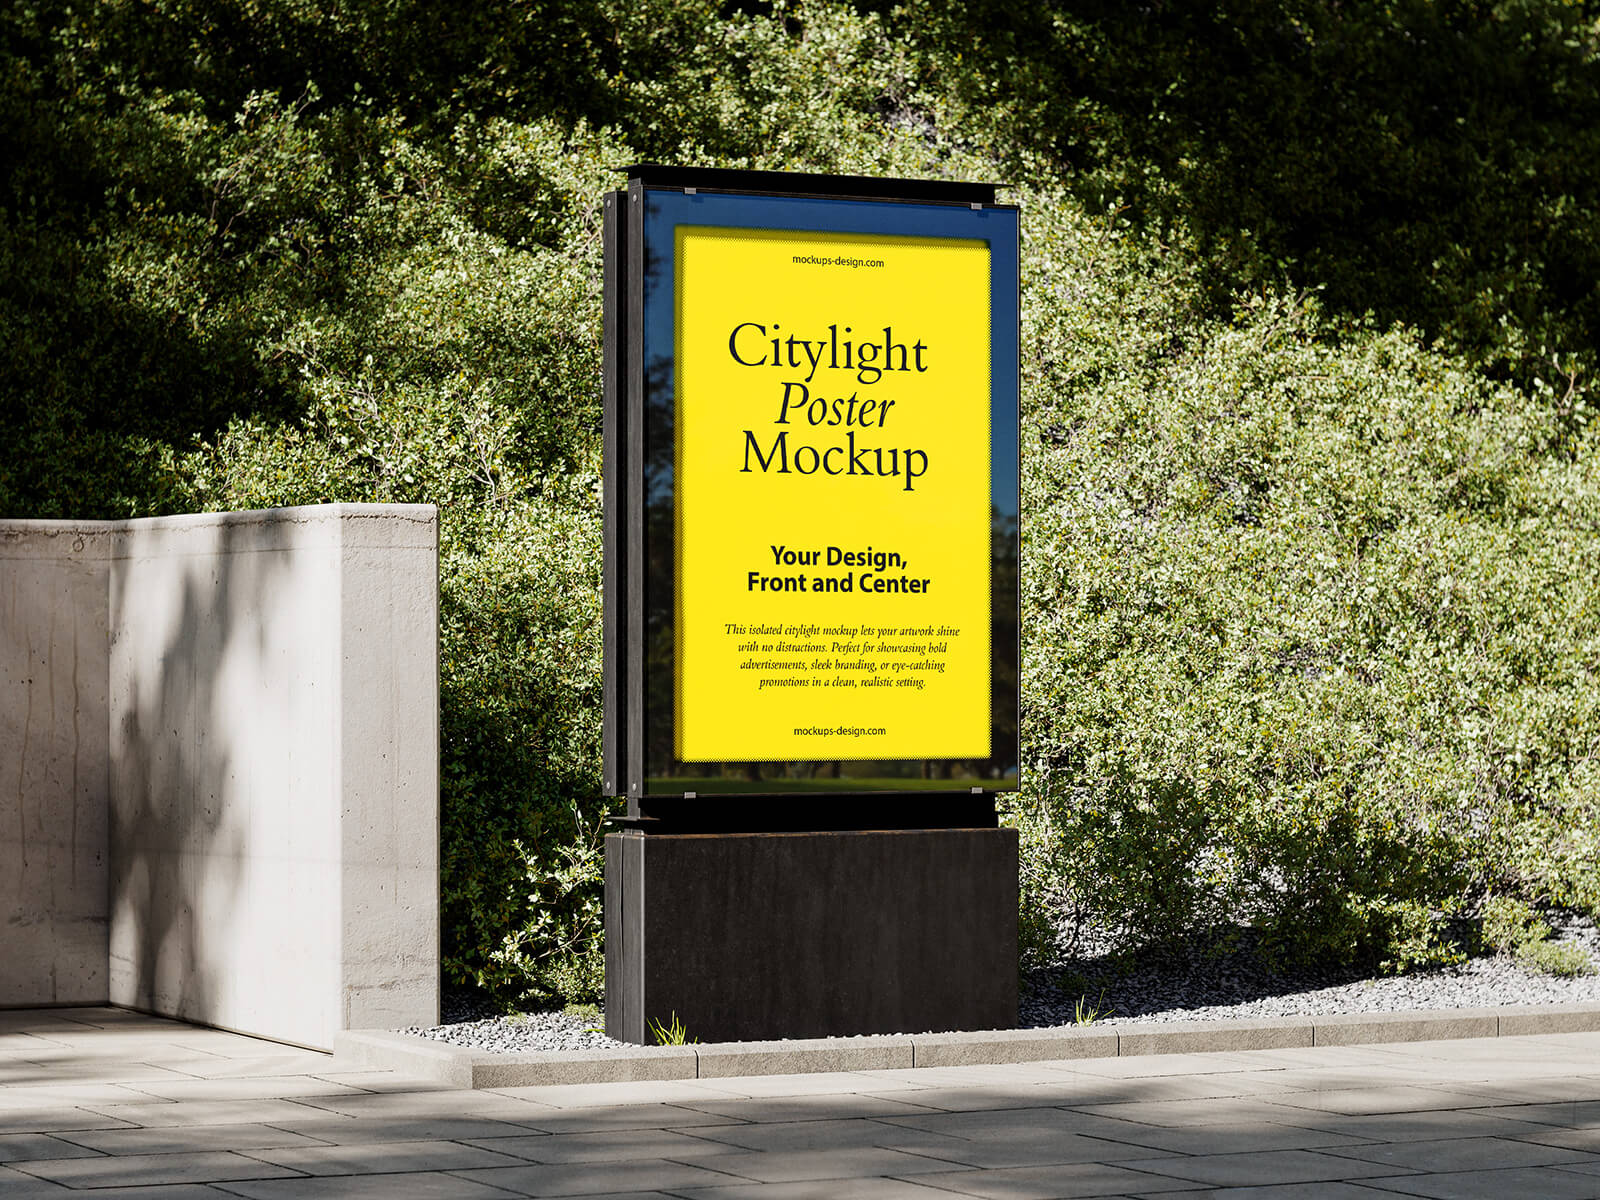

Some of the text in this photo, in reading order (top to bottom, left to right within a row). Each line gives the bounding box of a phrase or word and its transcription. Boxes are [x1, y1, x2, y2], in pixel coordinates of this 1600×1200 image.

[793, 256, 884, 268] mockups-design.com
[729, 323, 928, 385] Citylight
[774, 381, 895, 427] Poster
[740, 430, 928, 491] Mockup
[770, 546, 907, 573] Your Design,
[748, 572, 930, 593] Front and Center
[725, 624, 960, 639] This isolated citylight mockup lets your artwork shine
[739, 641, 758, 652] with
[776, 641, 827, 652] distractions.
[832, 641, 861, 655] Perfect
[861, 642, 875, 655] for
[877, 642, 926, 656] showcasing
[929, 642, 947, 653] bold
[740, 659, 807, 671] advertisements,
[811, 659, 832, 669] sleek
[835, 659, 877, 673] branding,
[892, 659, 945, 673] eye-catching
[759, 677, 809, 689] promotions
[812, 677, 821, 686] in
[832, 676, 857, 688] clean,
[861, 676, 893, 687] realistic
[896, 677, 925, 689] setting.
[794, 726, 886, 737] mockups-design.com
